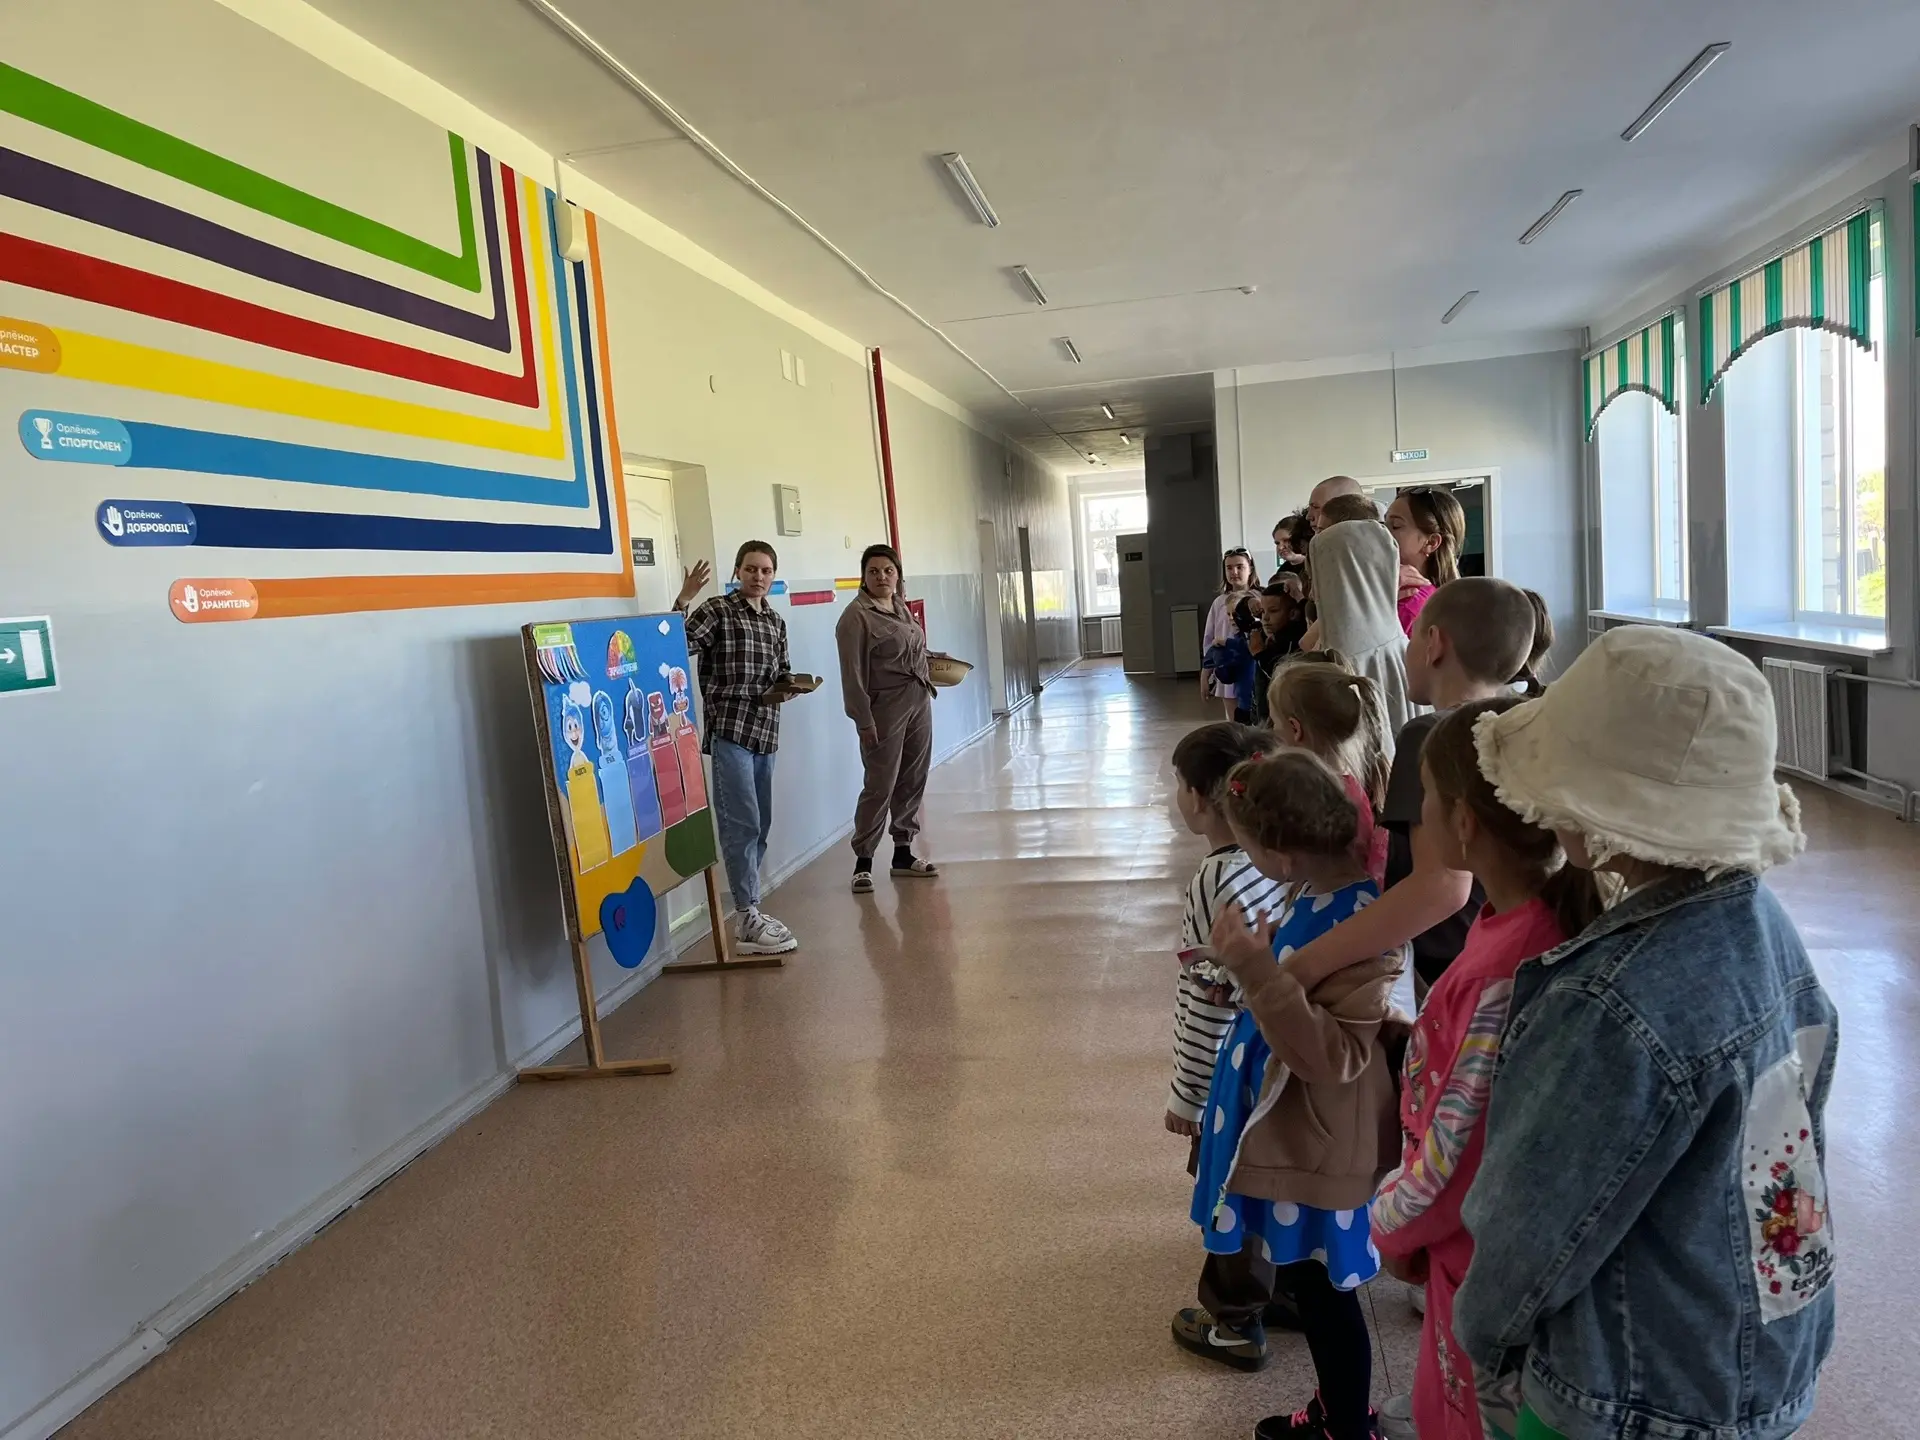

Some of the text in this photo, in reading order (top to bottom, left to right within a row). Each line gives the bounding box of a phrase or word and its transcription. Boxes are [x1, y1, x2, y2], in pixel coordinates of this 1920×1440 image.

[0, 329, 38, 344] рлёнок-
[56, 422, 100, 436] Орлёнок-
[58, 436, 122, 452] СПОРТСМЕН
[124, 509, 163, 521] Орлёнок-
[126, 523, 189, 534] ДОБРОВОЛЕЦ
[199, 588, 234, 598] Орлёнок-
[201, 599, 251, 610] ХРАНИТЕЛЬ
